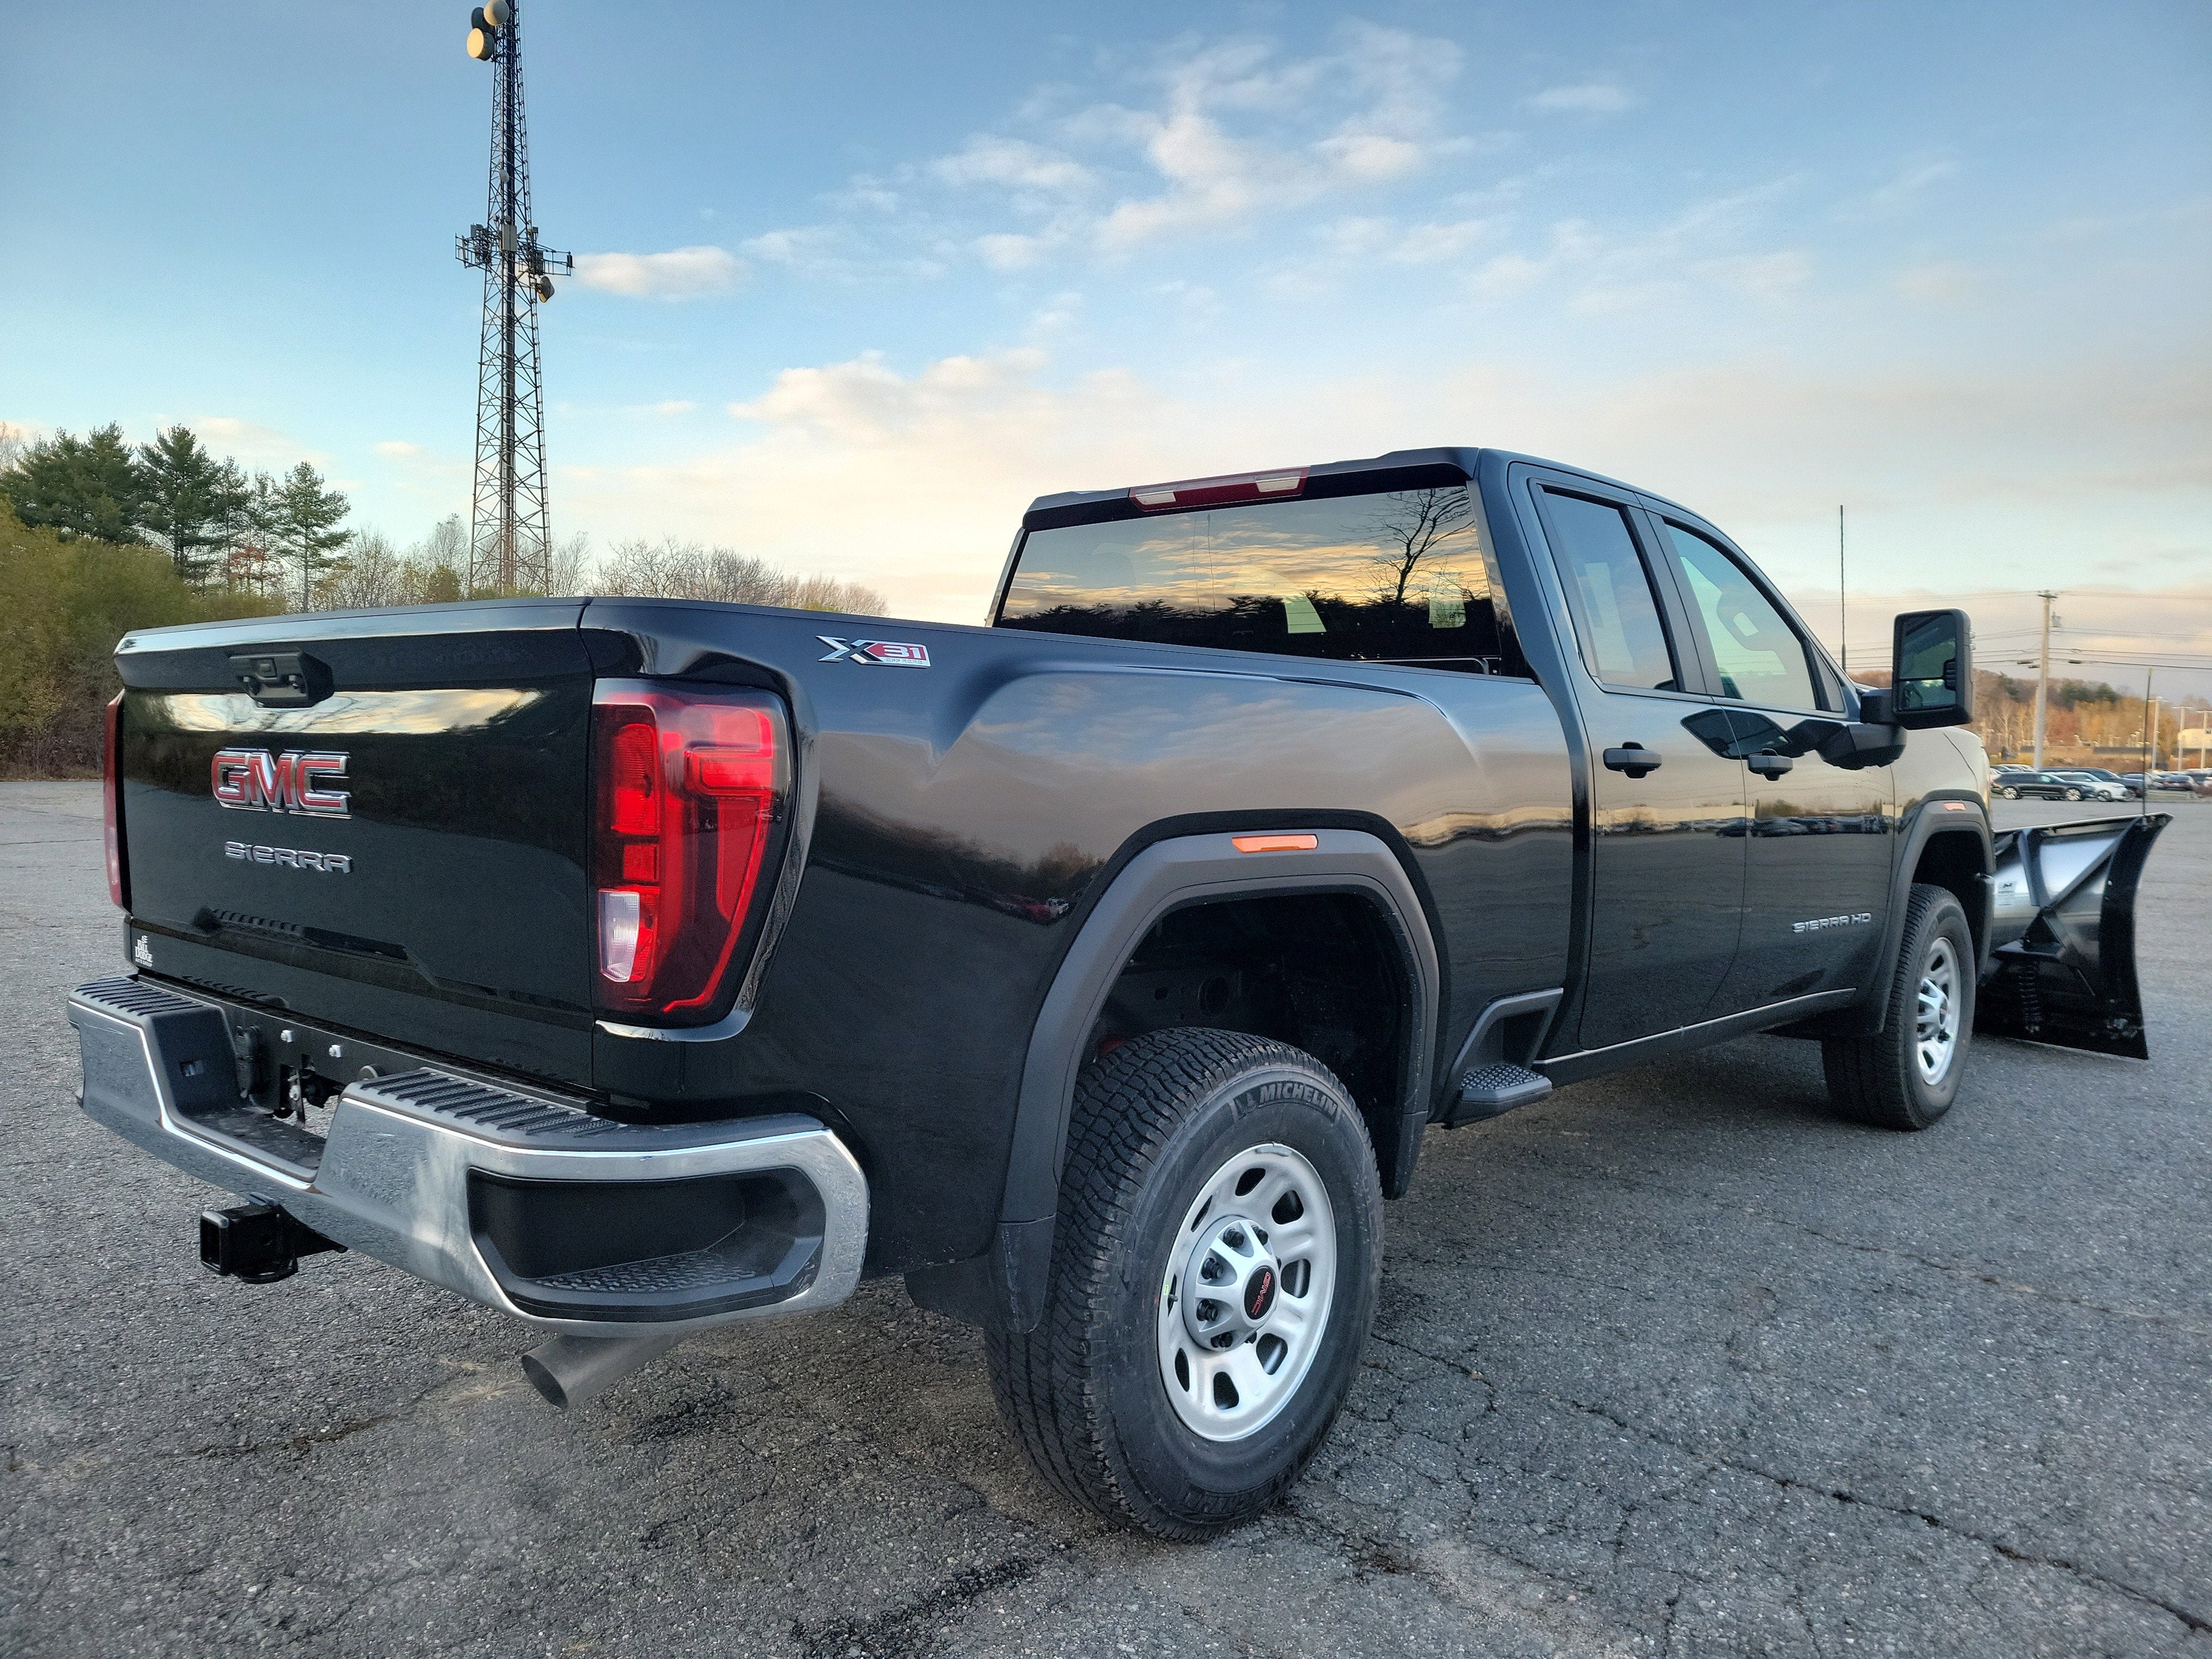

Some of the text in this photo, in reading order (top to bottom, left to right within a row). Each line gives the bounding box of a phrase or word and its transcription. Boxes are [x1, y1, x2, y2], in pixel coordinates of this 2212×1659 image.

[211, 749, 351, 816] GMC
[224, 841, 352, 873] SIERRA
[1792, 912, 1871, 933] SIERRA HD
[135, 946, 153, 963] DODGE
[137, 939, 149, 953] BILL
[1260, 1082, 1338, 1116] MICHELIN
[1251, 1272, 1271, 1315] GMC
